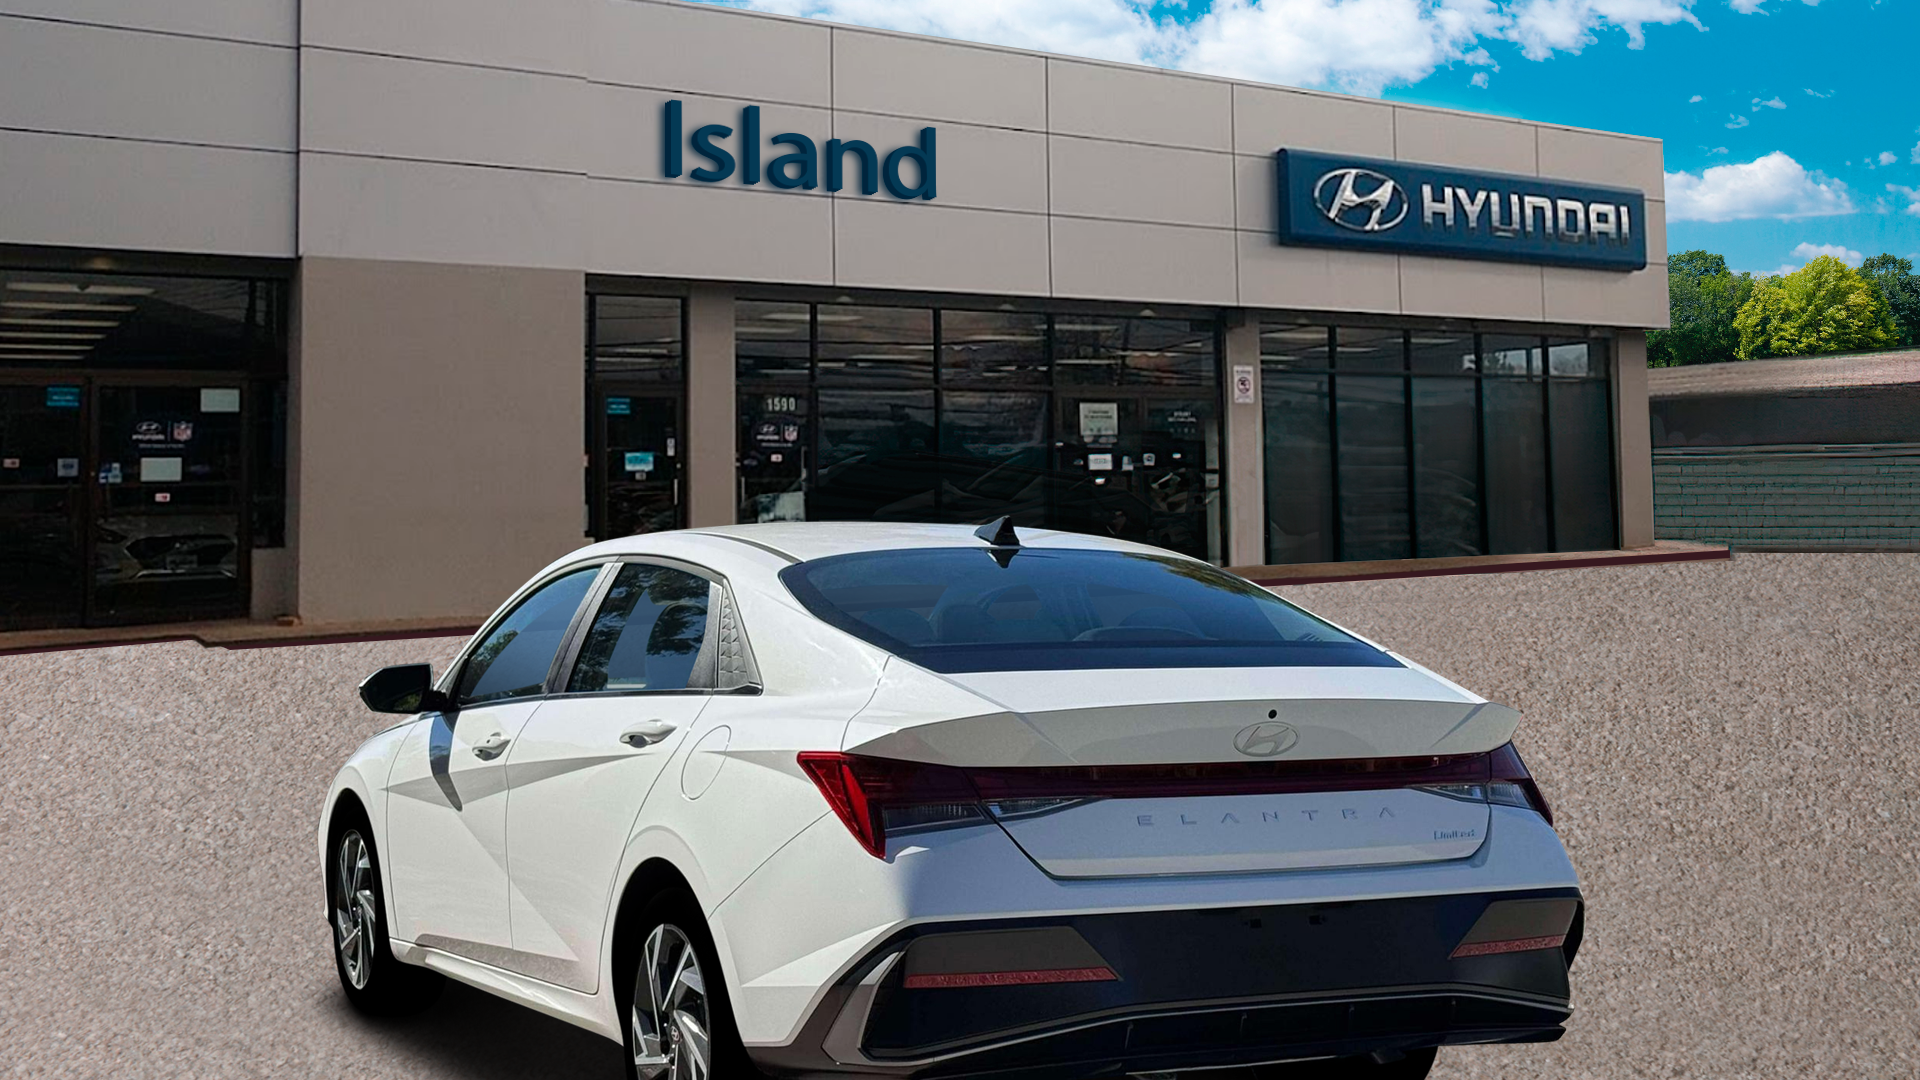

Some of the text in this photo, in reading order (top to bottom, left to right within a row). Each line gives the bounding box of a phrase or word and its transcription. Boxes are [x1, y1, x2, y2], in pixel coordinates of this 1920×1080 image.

[664, 99, 937, 201] Island
[1421, 183, 1631, 248] HYUNDAI
[767, 397, 796, 412] 1590
[1137, 806, 1396, 827] ELANTRA
